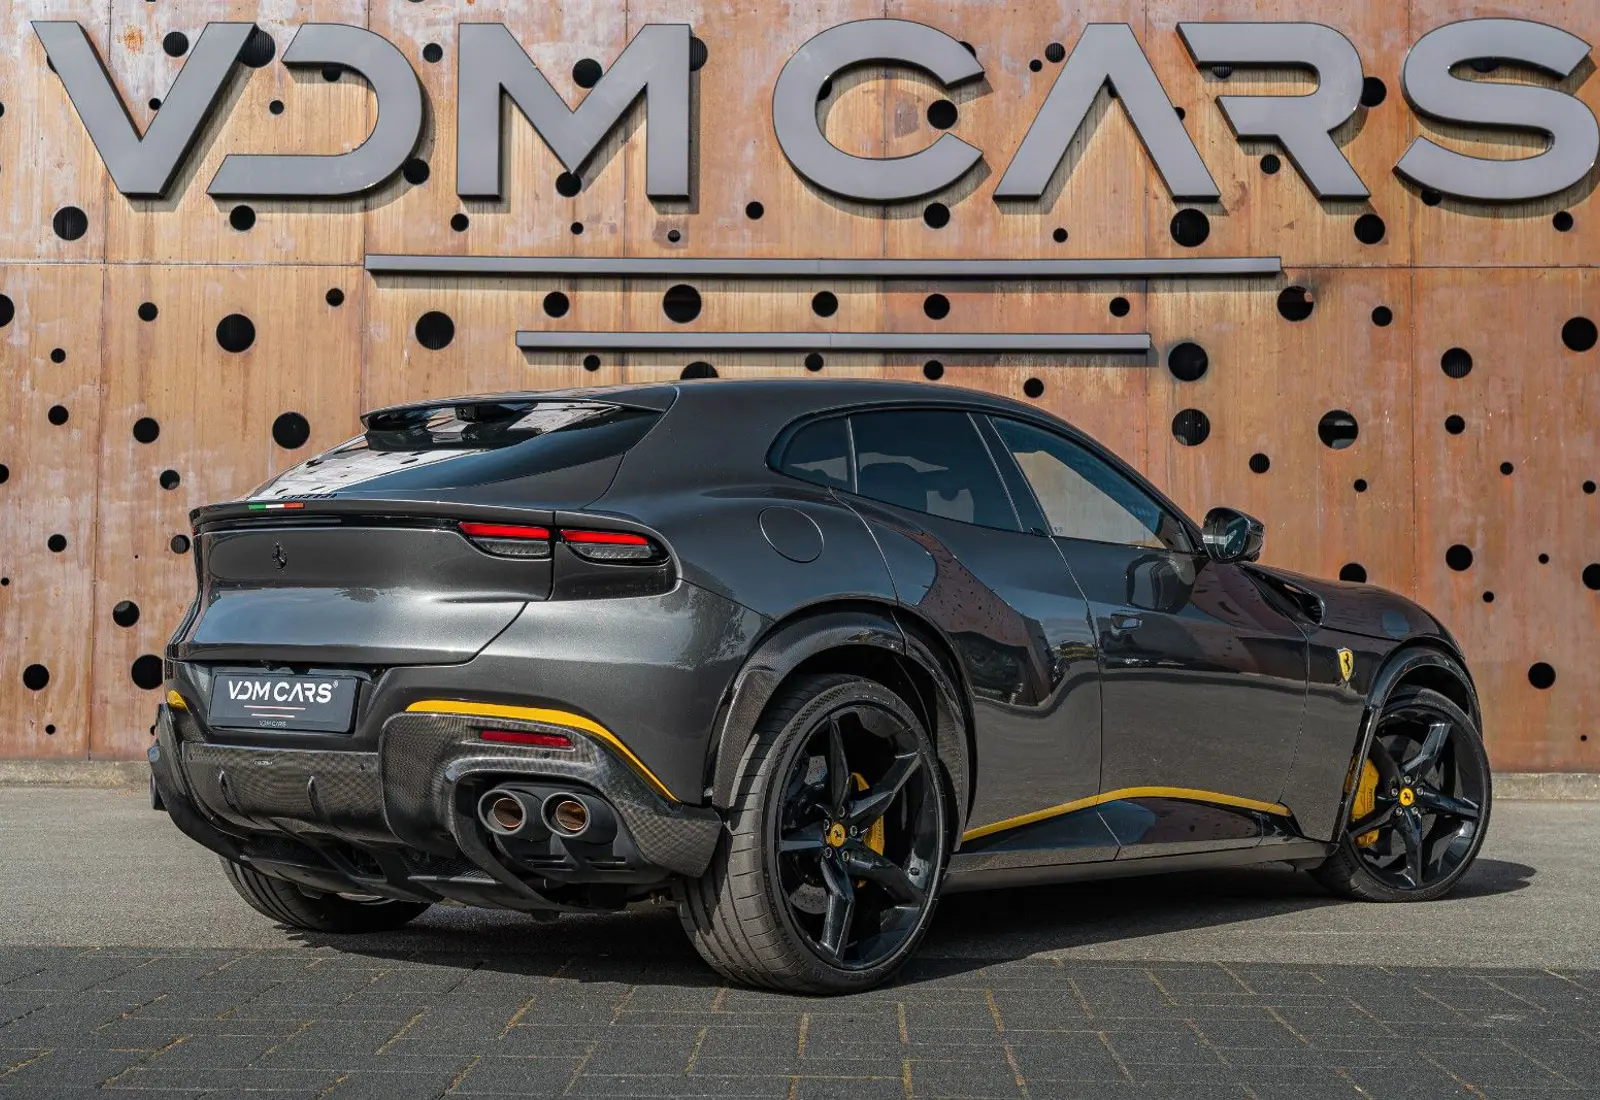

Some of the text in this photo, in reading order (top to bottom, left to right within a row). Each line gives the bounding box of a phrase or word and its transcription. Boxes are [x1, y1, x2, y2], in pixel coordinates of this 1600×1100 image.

[31, 18, 1600, 202] VDM CARS
[228, 680, 271, 700] VDM
